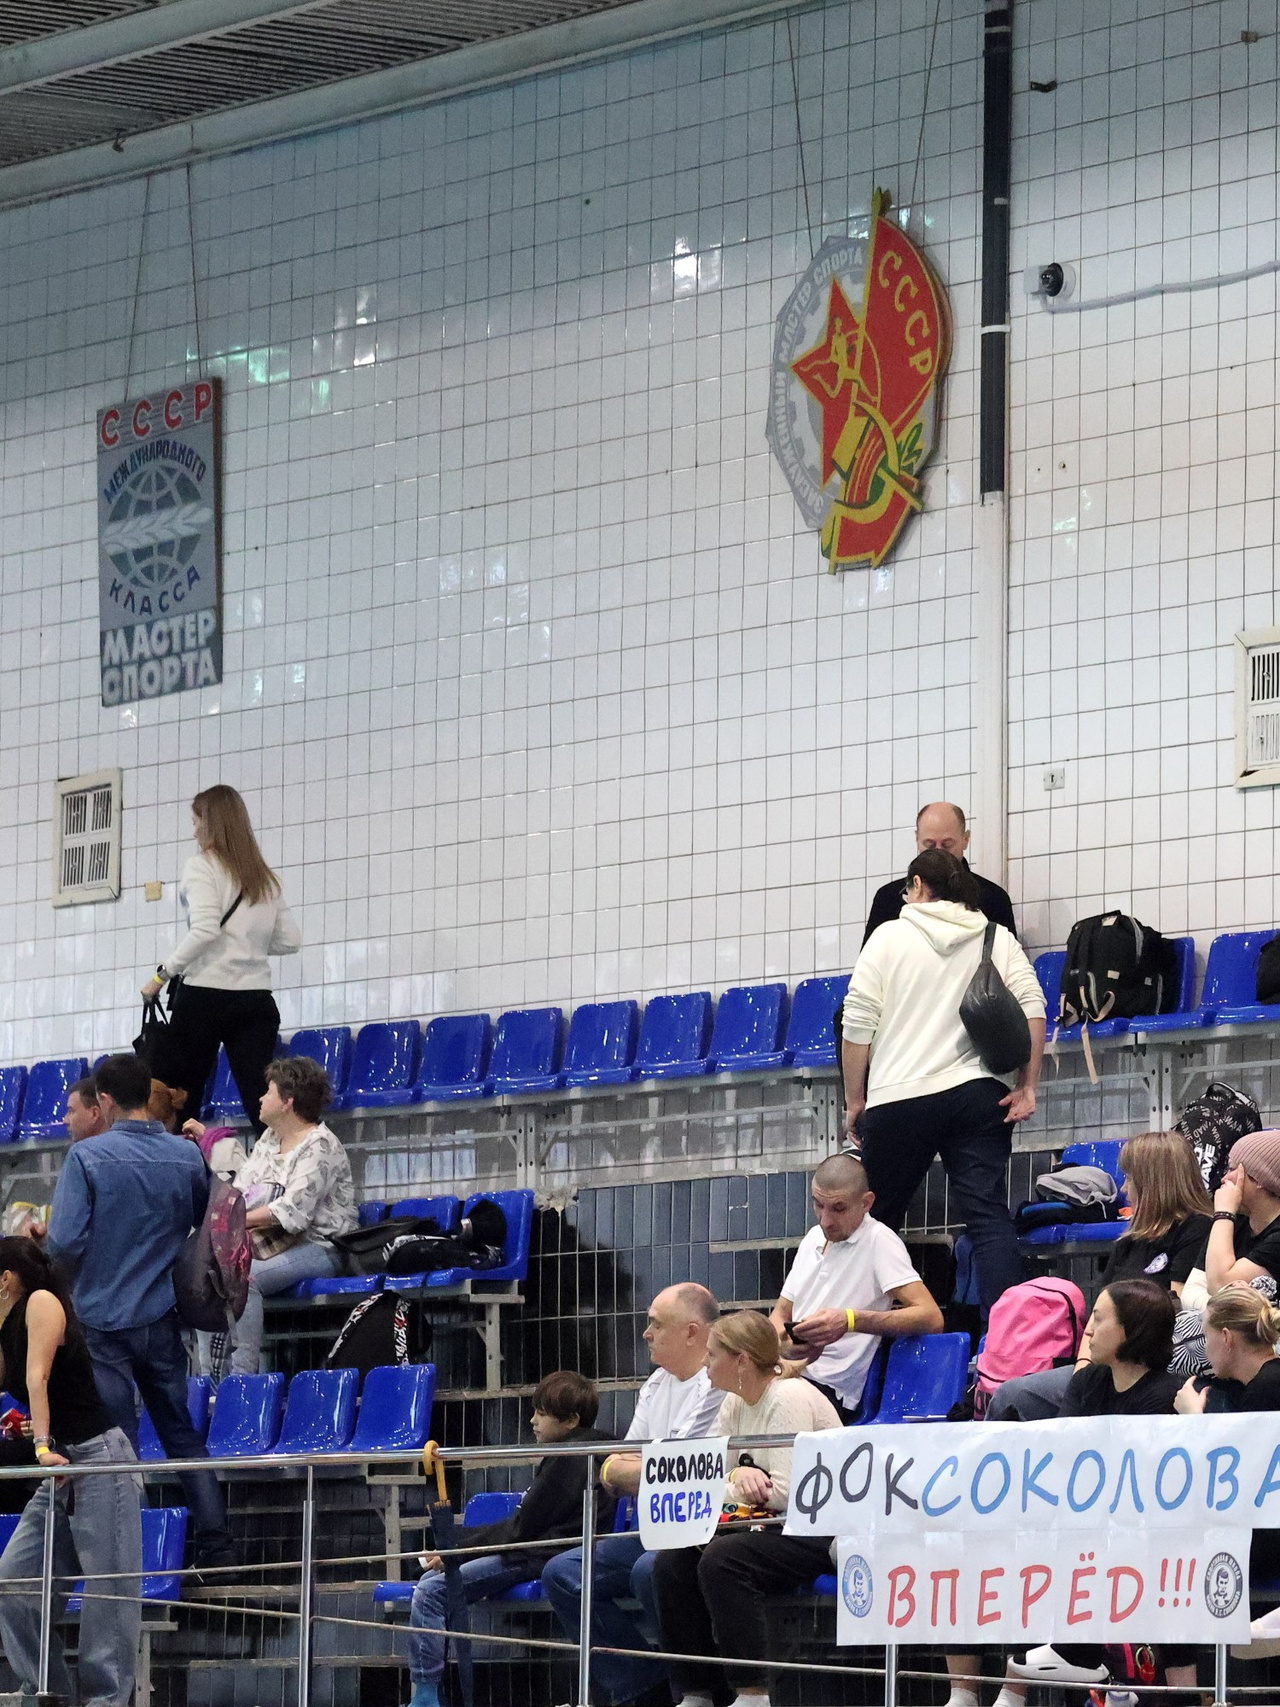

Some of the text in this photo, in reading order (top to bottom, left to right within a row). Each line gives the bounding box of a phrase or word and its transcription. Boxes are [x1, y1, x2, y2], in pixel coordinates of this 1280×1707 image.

[813, 246, 864, 282] СПОРТА
[878, 250, 933, 375] СССР
[100, 381, 213, 447] СССР
[103, 439, 207, 505] МЕЖДУНАРОДНОГО
[110, 564, 200, 616] КЛАССА
[102, 607, 216, 667] МАСТЕР
[102, 647, 218, 706] СПОРТА
[646, 1452, 724, 1484] СОКОЛОВА
[650, 1490, 712, 1523] ВПЕРЕД
